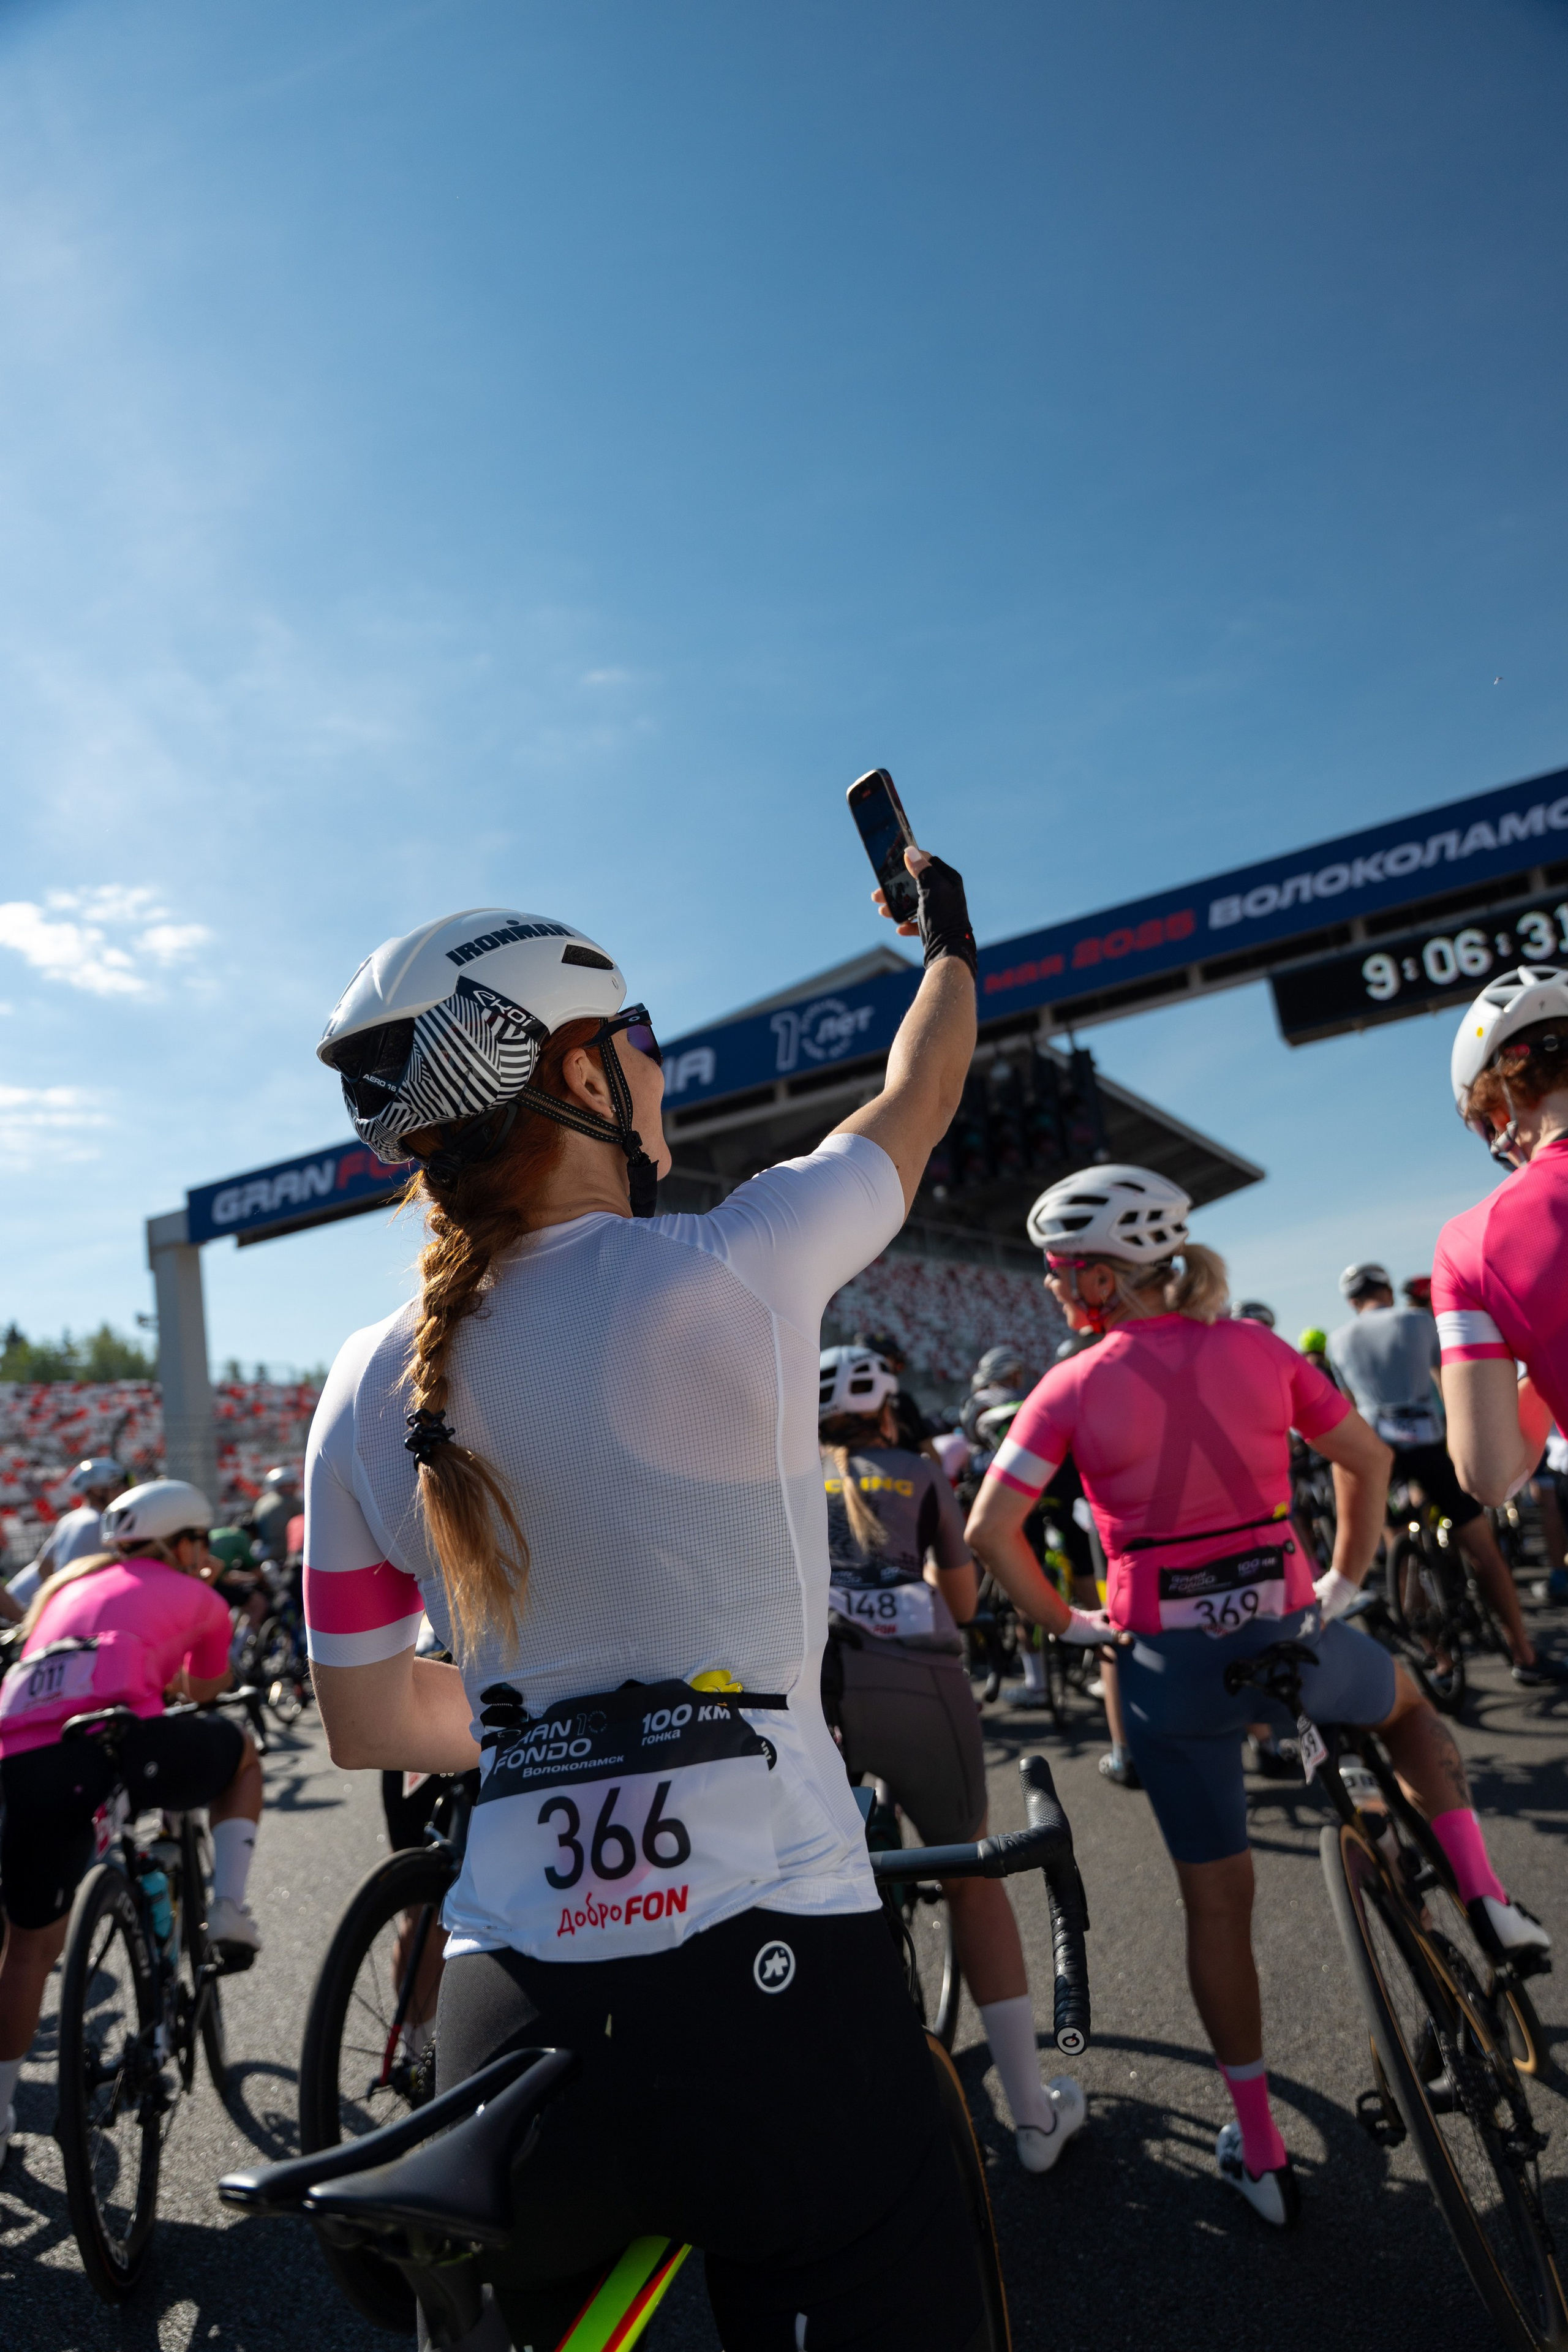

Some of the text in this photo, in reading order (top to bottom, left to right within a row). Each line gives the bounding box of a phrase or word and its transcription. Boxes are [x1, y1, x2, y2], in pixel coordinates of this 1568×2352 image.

[445, 920, 575, 967] IRONMAN
[1072, 908, 1196, 970] 2025
[363, 1074, 397, 1092] AERO 16
[1171, 1571, 1207, 1583] GRAN
[1238, 1558, 1258, 1571] 100
[1169, 1575, 1216, 1591] FONDO
[1194, 1589, 1259, 1626] 369
[643, 1703, 693, 1734] 100
[641, 1728, 681, 1746] гонка
[493, 1738, 592, 1775] FONDO
[522, 1755, 624, 1779] Волоколамск
[537, 1780, 692, 1890] 366
